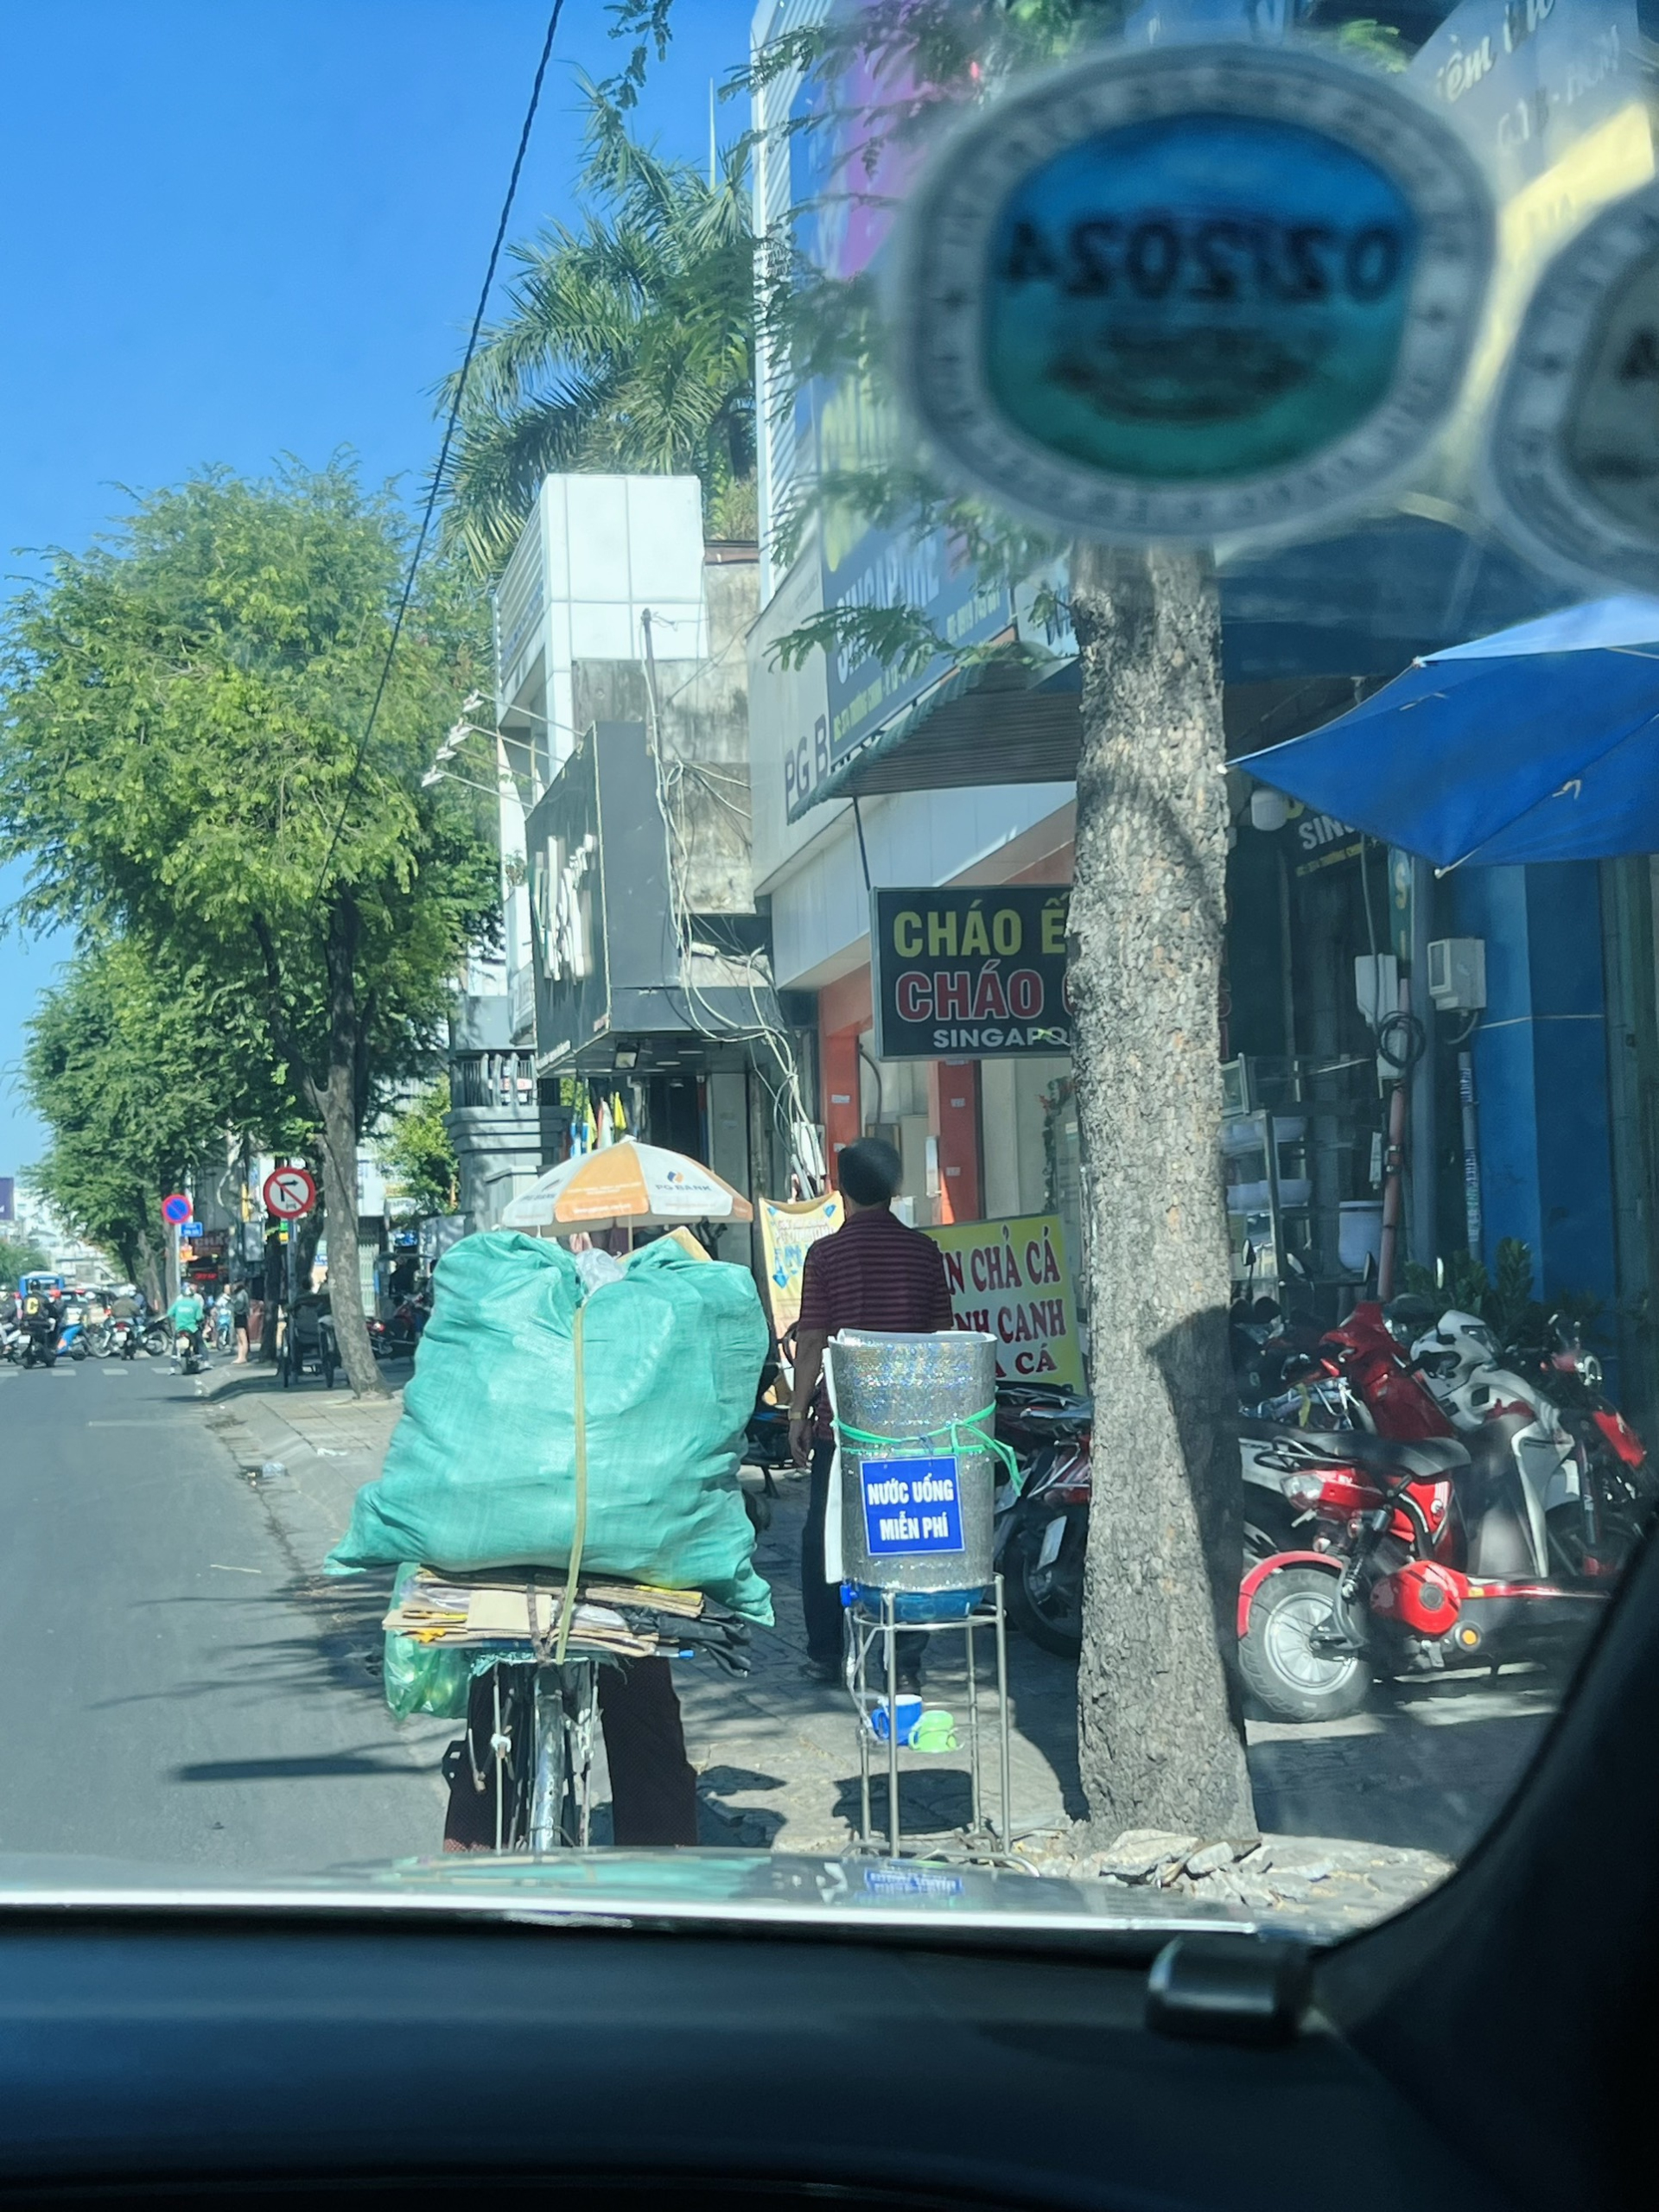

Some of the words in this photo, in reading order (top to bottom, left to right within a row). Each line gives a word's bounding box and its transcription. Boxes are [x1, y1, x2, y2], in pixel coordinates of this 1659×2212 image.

[1298, 815, 1356, 850] SIN
[893, 899, 1022, 958] CHÁO
[1040, 891, 1070, 955] Ế
[895, 959, 1045, 1023] CHÁO
[933, 1026, 1069, 1050] SINGAPO
[944, 1251, 966, 1296] N
[970, 1224, 1023, 1293] CHẢ
[1026, 1225, 1061, 1286] CÁ
[953, 1308, 990, 1333] NH
[997, 1299, 1066, 1344] CANH
[1014, 1342, 1058, 1375] CÁ
[867, 1478, 910, 1506] NƯỚC
[912, 1472, 955, 1503] UỐNG
[879, 1510, 921, 1541] MIỄN
[921, 1511, 950, 1540] PHÍ
